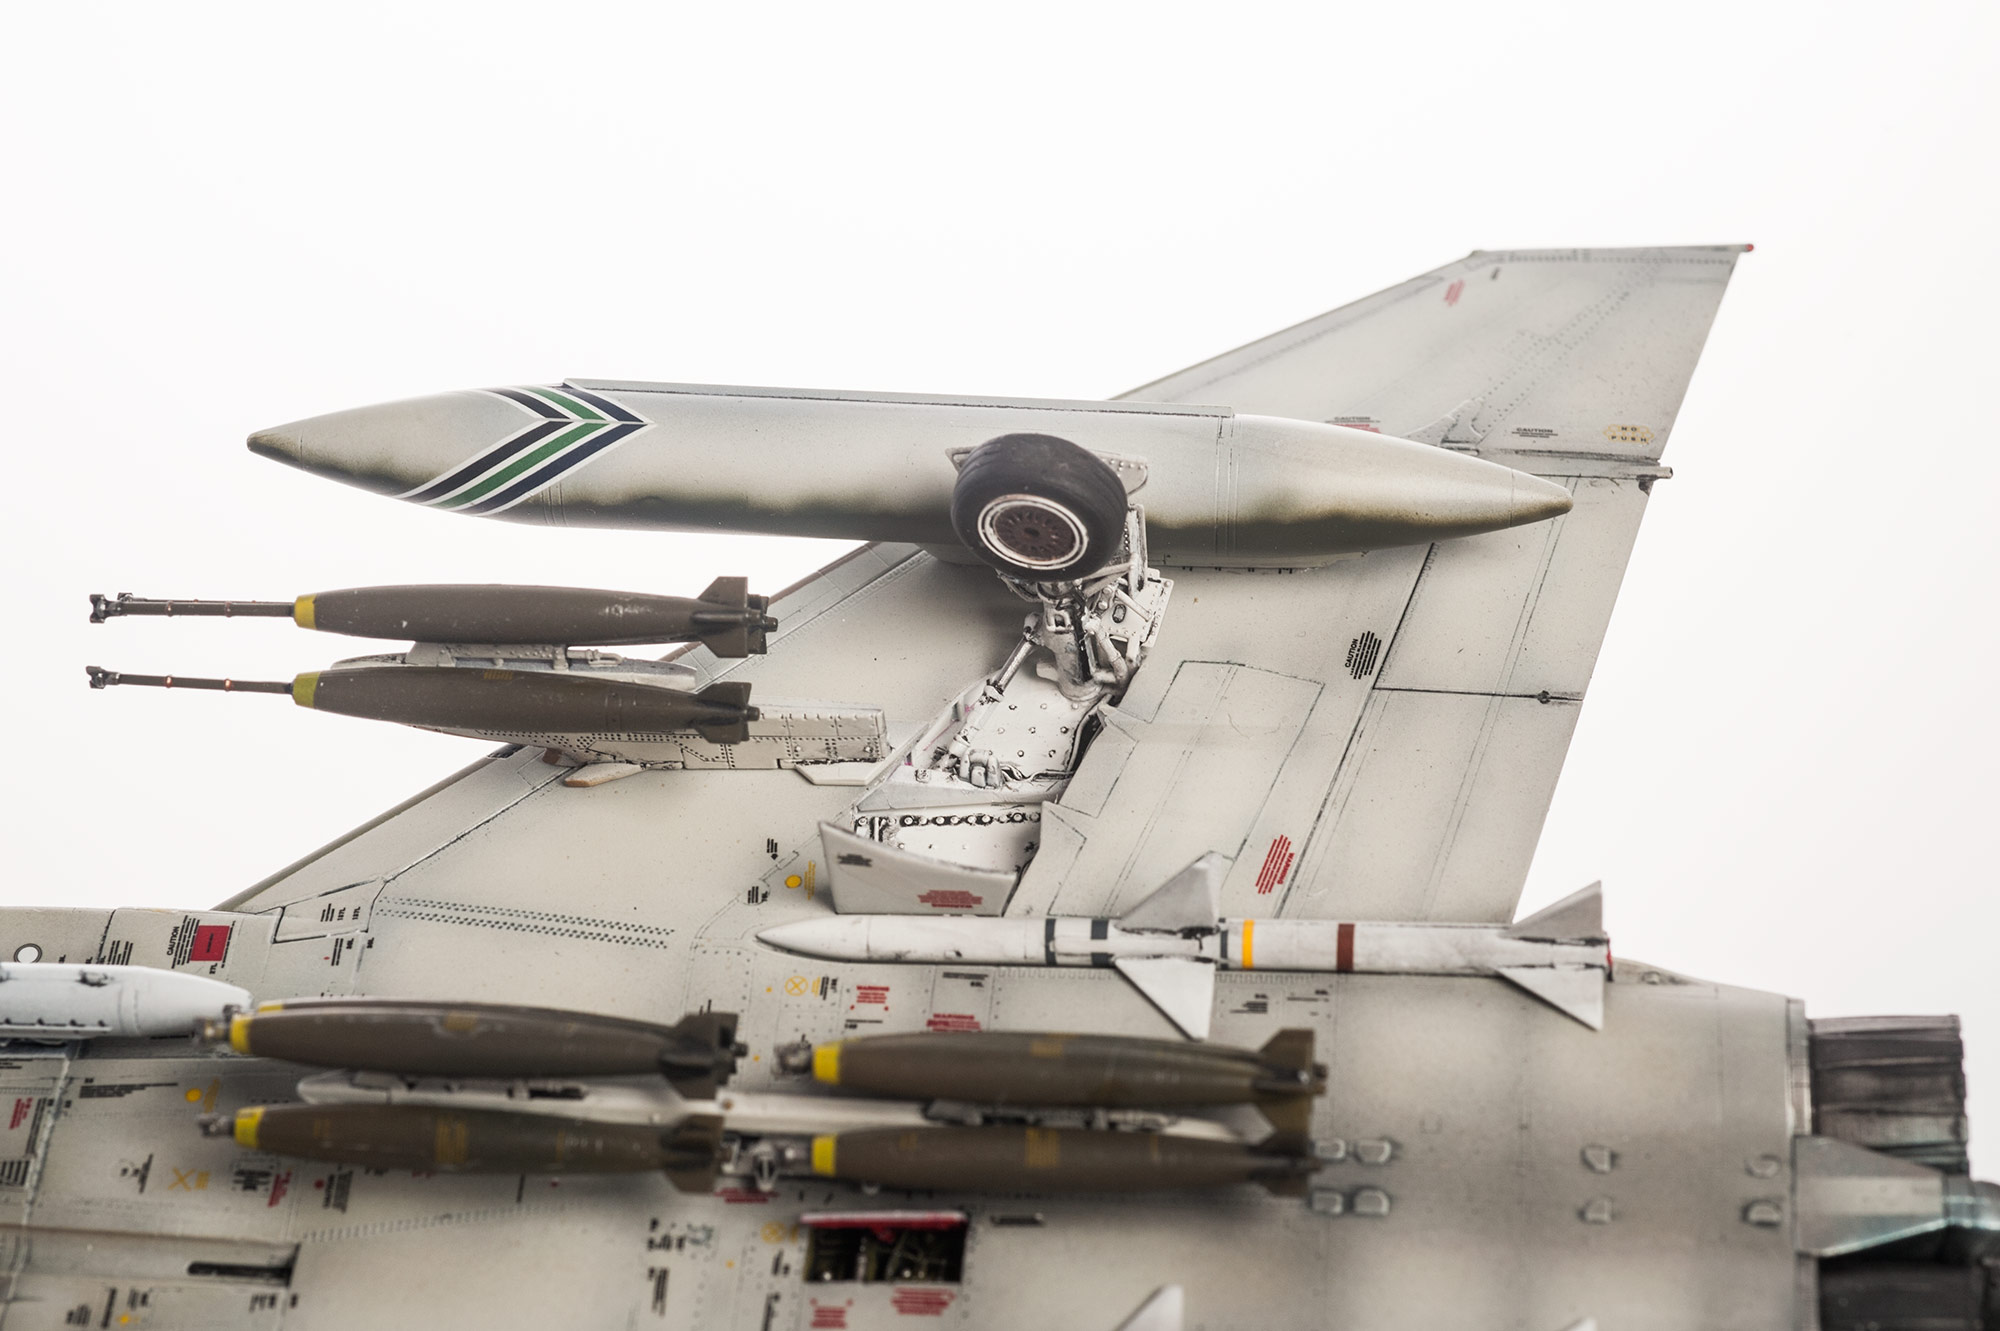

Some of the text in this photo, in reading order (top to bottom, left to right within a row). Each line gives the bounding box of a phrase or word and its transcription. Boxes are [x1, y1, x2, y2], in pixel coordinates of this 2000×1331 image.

[1344, 638, 1359, 668] CAUTION
[1277, 852, 1295, 885] WARNING
[166, 926, 180, 956] CAUTION
